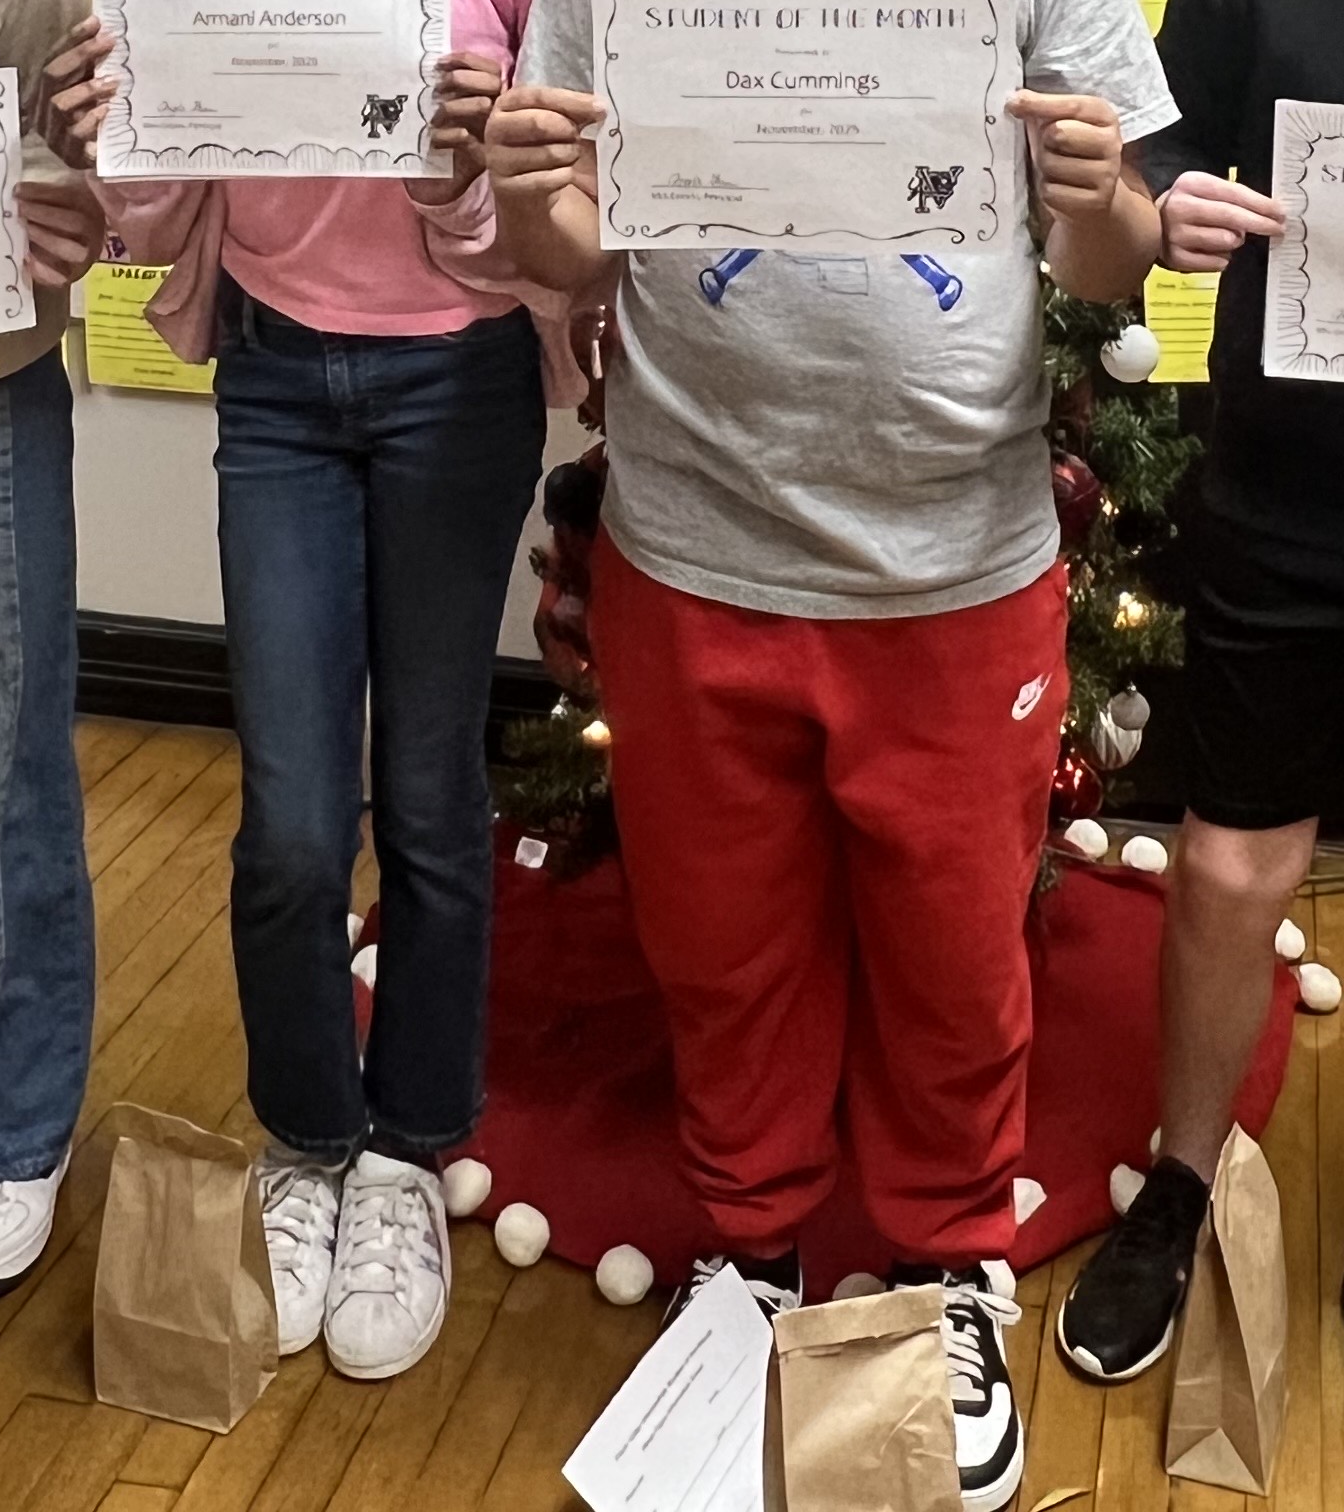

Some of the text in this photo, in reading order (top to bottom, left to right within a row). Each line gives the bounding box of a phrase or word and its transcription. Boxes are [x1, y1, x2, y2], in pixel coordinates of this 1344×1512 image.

[192, 9, 347, 27] Armani Anderson
[644, 6, 967, 29] STUDENT OF THE MONTH
[725, 70, 881, 96] Dax Cummings
